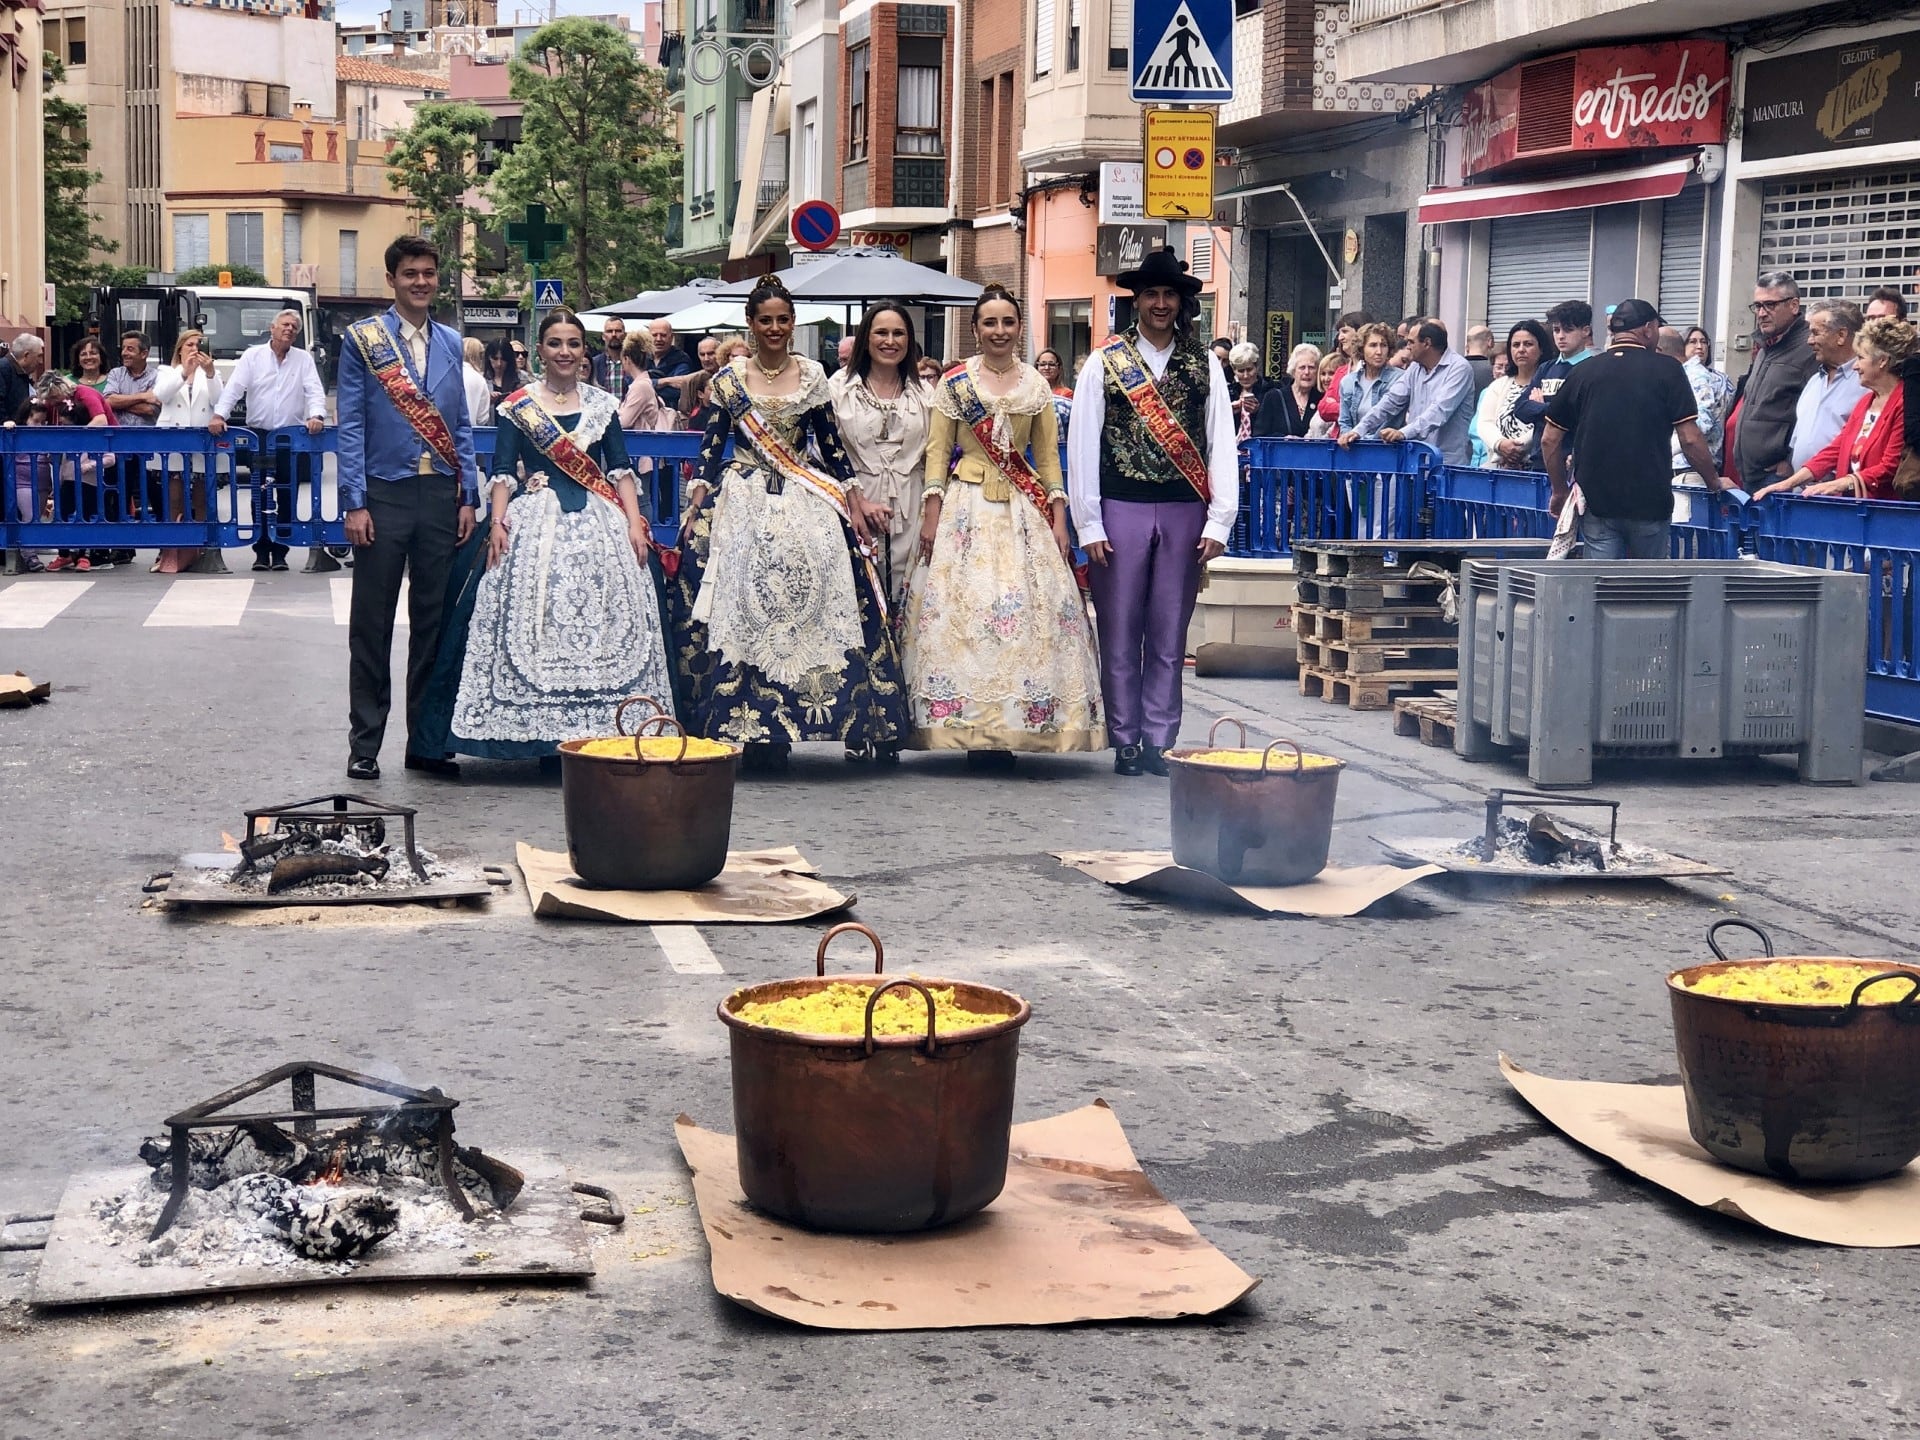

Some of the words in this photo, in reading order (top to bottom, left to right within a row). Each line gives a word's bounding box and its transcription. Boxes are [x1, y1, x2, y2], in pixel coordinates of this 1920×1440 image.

[1841, 49, 1876, 65] CREATIVE
[1574, 49, 1730, 139] entredos
[1752, 100, 1805, 123] MANICURA
[1111, 166, 1126, 183] La
[852, 231, 909, 247] TODO
